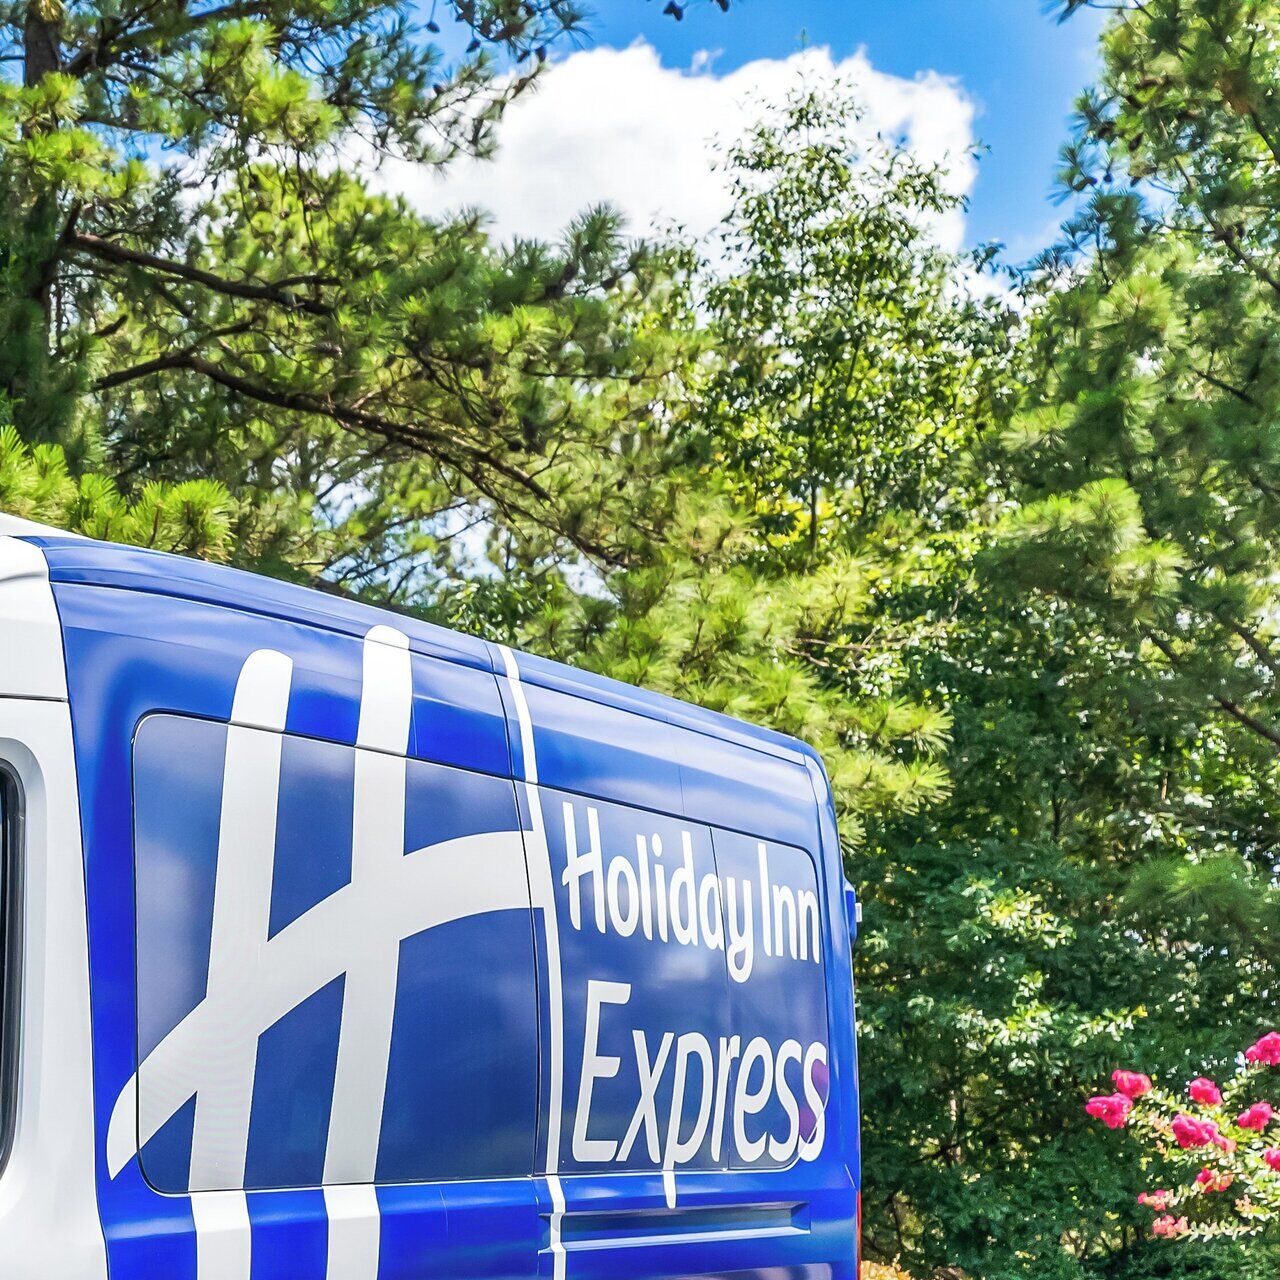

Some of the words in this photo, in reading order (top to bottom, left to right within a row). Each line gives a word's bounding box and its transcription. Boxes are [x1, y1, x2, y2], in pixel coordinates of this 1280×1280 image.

[562, 802, 752, 984] Holiday
[757, 842, 821, 964] Inn
[572, 980, 829, 1209] Express
